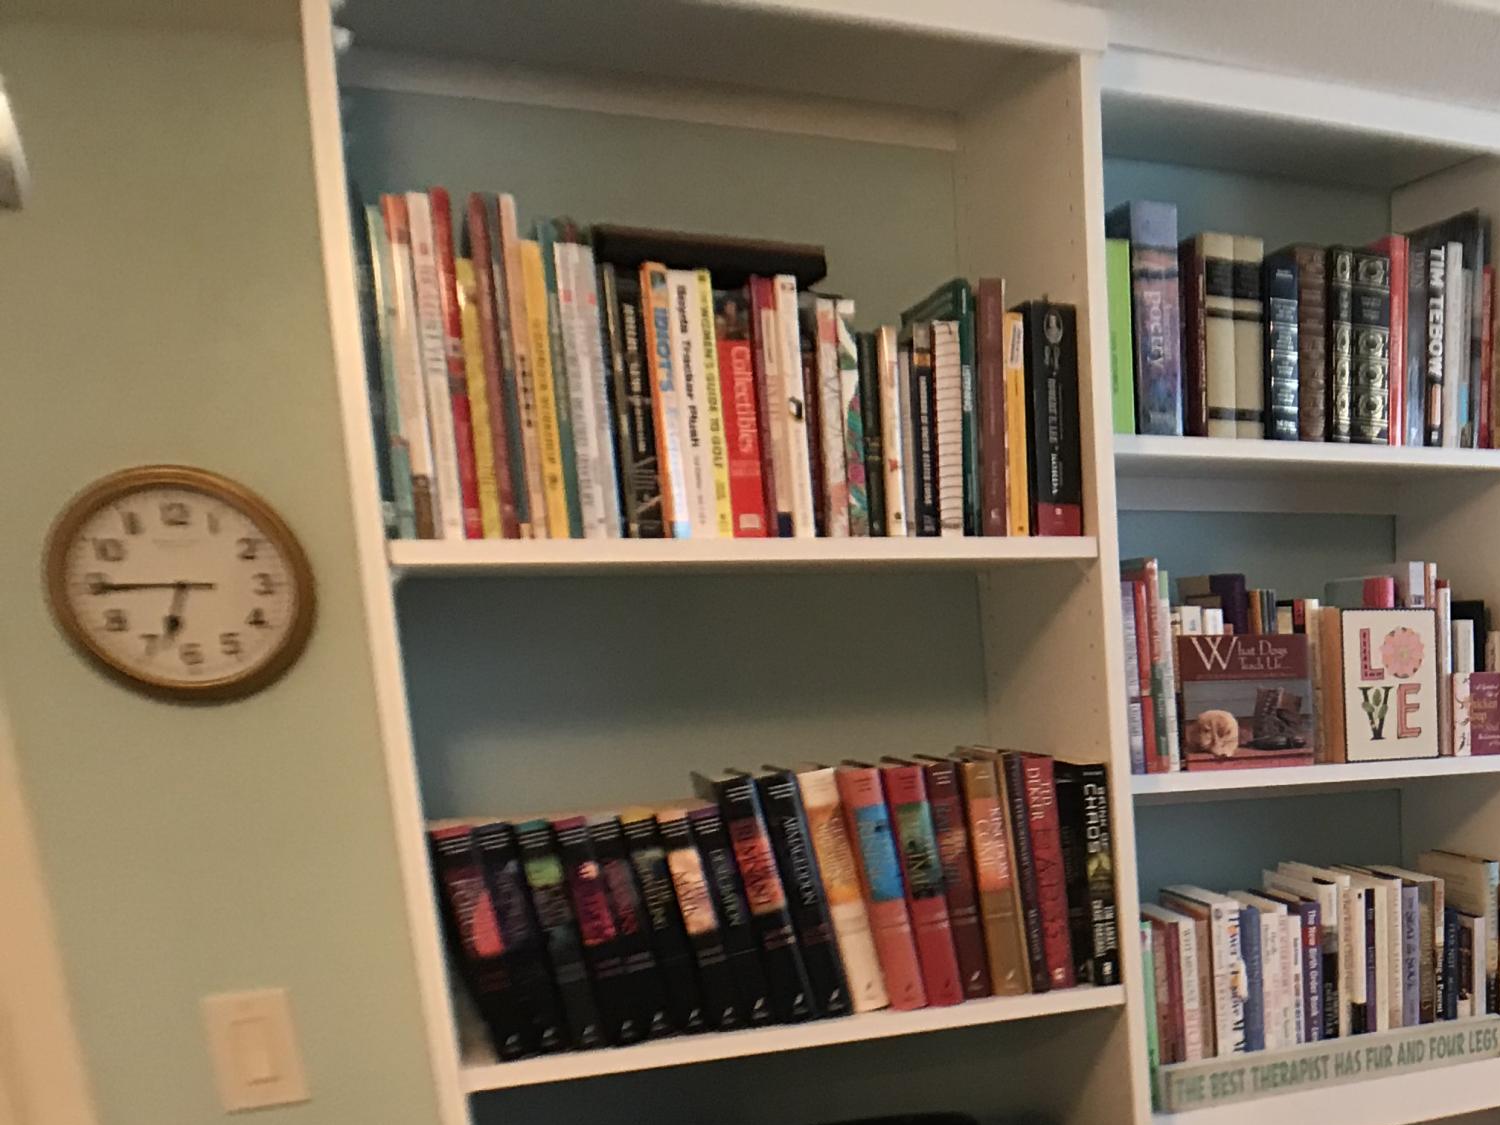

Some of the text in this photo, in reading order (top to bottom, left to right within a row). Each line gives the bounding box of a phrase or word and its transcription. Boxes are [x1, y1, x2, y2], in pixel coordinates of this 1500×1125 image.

[1144, 289, 1166, 369] poetry
[1428, 247, 1444, 379] TIM TEBOW
[706, 373, 718, 412] GUIDE
[730, 345, 758, 453] Collectibles
[710, 417, 719, 432] TO
[711, 435, 723, 469] GOLF
[1191, 636, 1287, 671] What Dogs
[1240, 657, 1264, 670] Teach
[1026, 767, 1045, 821] DEKKER
[1082, 783, 1101, 853] CHAOS
[735, 821, 772, 908] REMNANT
[782, 813, 819, 907] ARMAGEDDON
[1308, 910, 1316, 925] The
[1406, 911, 1414, 940] SEAT
[1308, 927, 1316, 946] New
[1309, 948, 1317, 969] Birth
[1310, 996, 1318, 1016] Book
[1175, 1027, 1500, 1102] THE BEST THERAPIST HAS FUR AND FOUR LEGS
